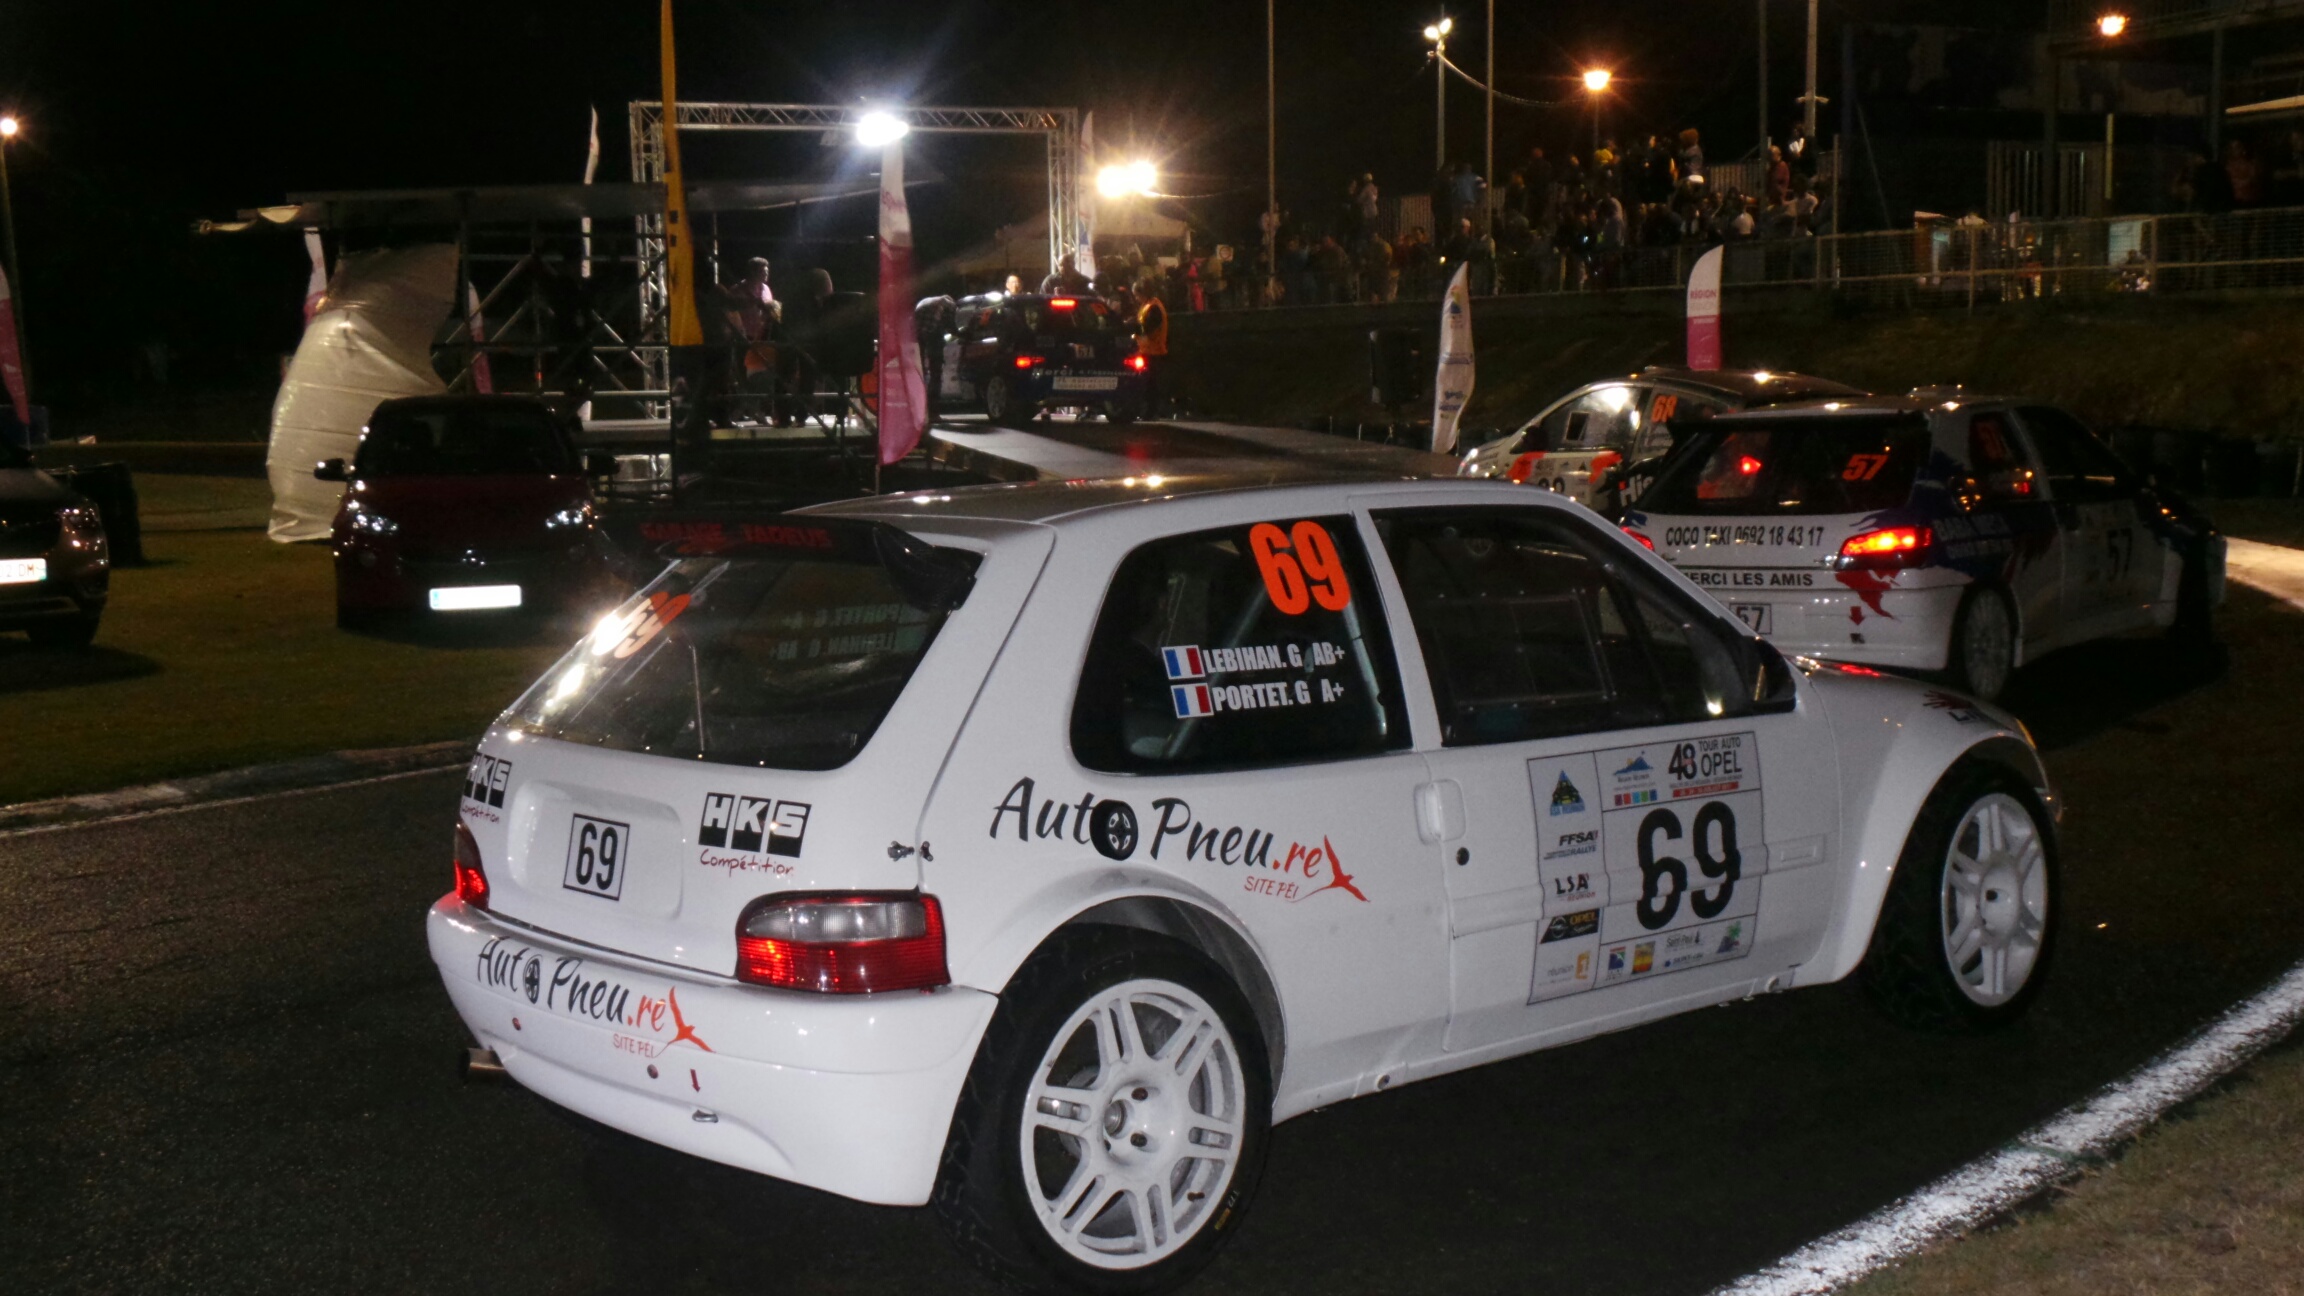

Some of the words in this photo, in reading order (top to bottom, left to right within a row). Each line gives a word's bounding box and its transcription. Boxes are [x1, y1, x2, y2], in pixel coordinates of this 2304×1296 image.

[1842, 454, 1888, 480] 57
[1666, 526, 1699, 546] COCO
[1704, 525, 1731, 546] TAXI
[1734, 525, 1765, 546] 0692
[1769, 526, 1785, 546] 18
[1787, 526, 1803, 546] 43
[1808, 526, 1824, 546] 17
[1249, 520, 1351, 615] 69
[1733, 573, 1764, 586] LES
[1770, 573, 1814, 586] AMIS
[1735, 606, 1765, 633] 57
[1203, 645, 1287, 673] LEBIHAN.
[1287, 643, 1303, 667] G
[1312, 641, 1346, 666] AB+
[1212, 682, 1293, 711] PORTET.
[1294, 680, 1311, 705] G
[1320, 678, 1345, 703] A+
[1699, 740, 1719, 751] TOUR
[1722, 736, 1741, 749] AUTO
[1701, 750, 1742, 777] OPEL
[700, 793, 811, 848] HKS
[1150, 797, 1322, 879] Pneu.re
[576, 821, 620, 892] 69
[1637, 801, 1741, 931] 69
[1244, 875, 1273, 897] SITE
[1555, 873, 1589, 895] LSA
[547, 955, 666, 1032] Pneu.re
[613, 1033, 636, 1054] SITE
